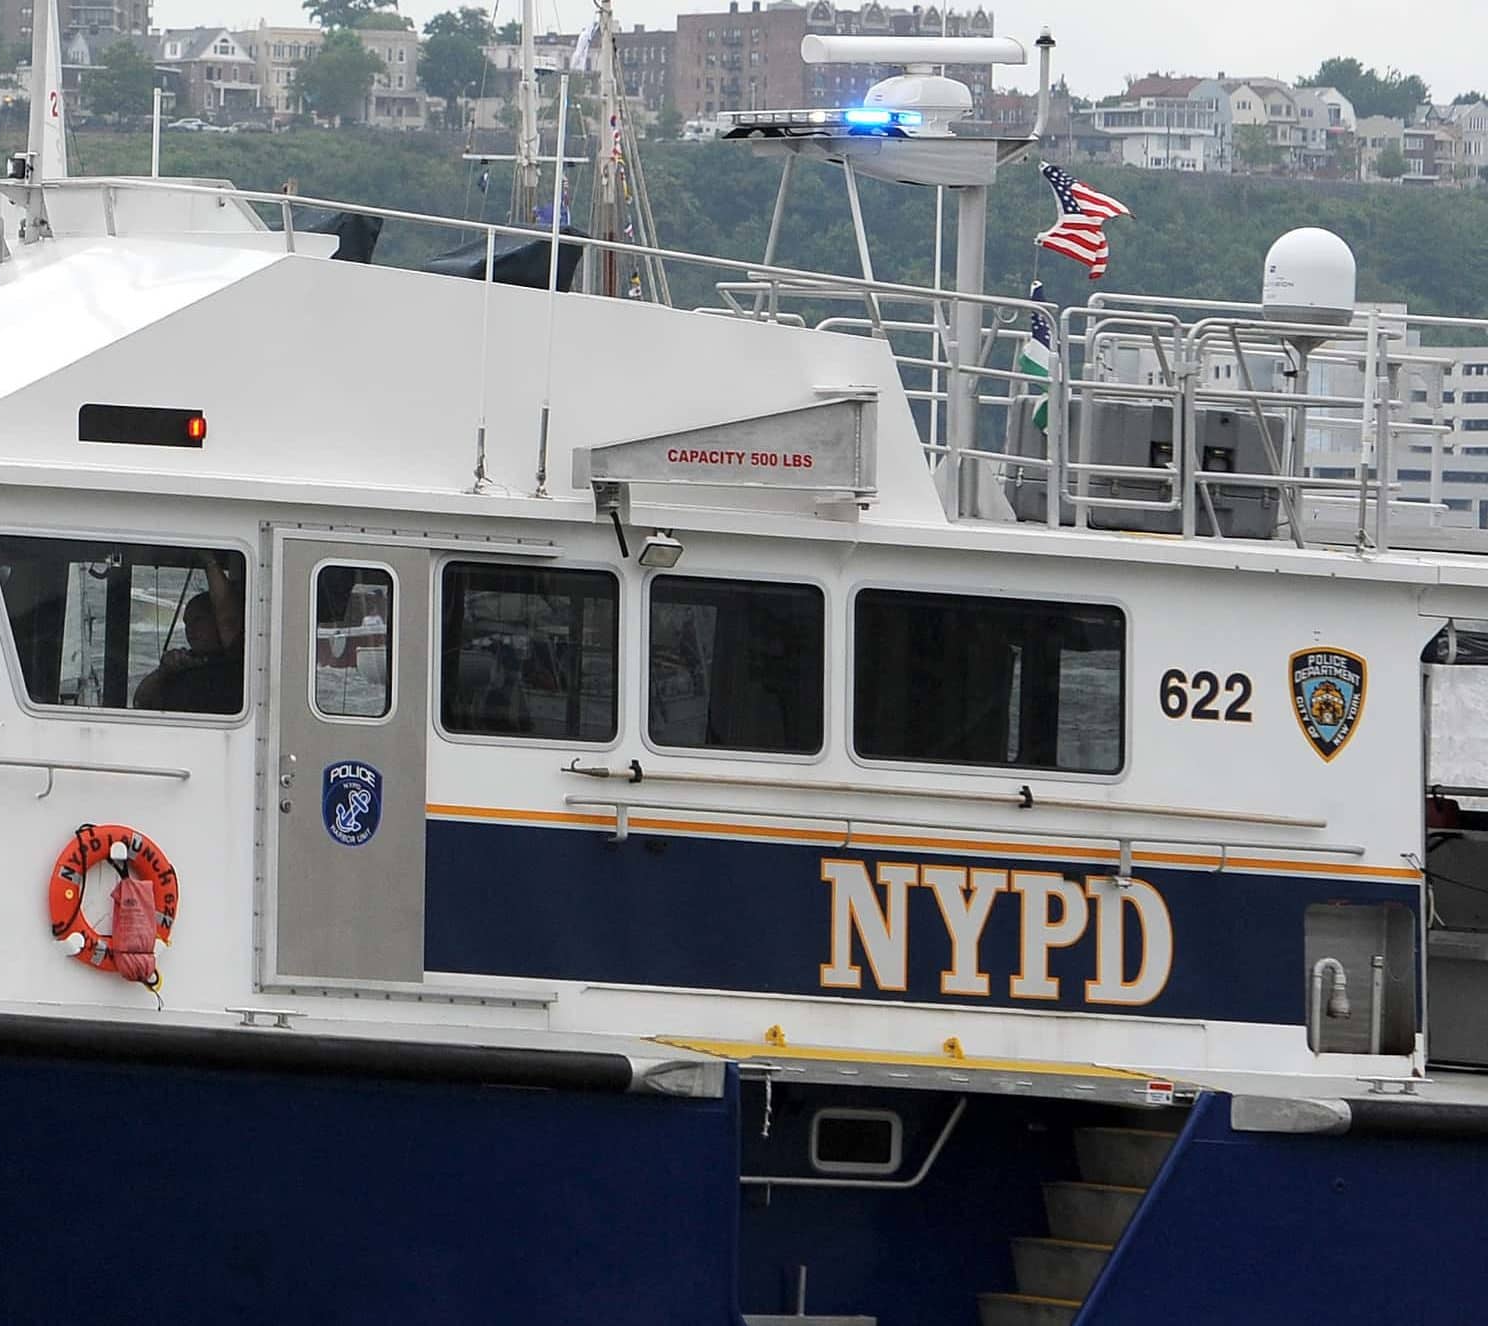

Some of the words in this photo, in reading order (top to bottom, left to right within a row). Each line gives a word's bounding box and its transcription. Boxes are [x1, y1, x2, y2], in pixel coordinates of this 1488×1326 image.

[667, 449, 745, 465] CAPACITY
[751, 452, 778, 466] 500
[783, 454, 813, 468] LBS
[1307, 654, 1348, 669] POLICE
[1295, 664, 1361, 686] DEPARTMENT
[1160, 669, 1252, 722] 622
[1296, 696, 1310, 721] CITY
[1307, 726, 1321, 739] OF
[1332, 724, 1349, 746] NEW
[330, 764, 376, 788] POLICE
[819, 858, 1174, 1006] NYPD
